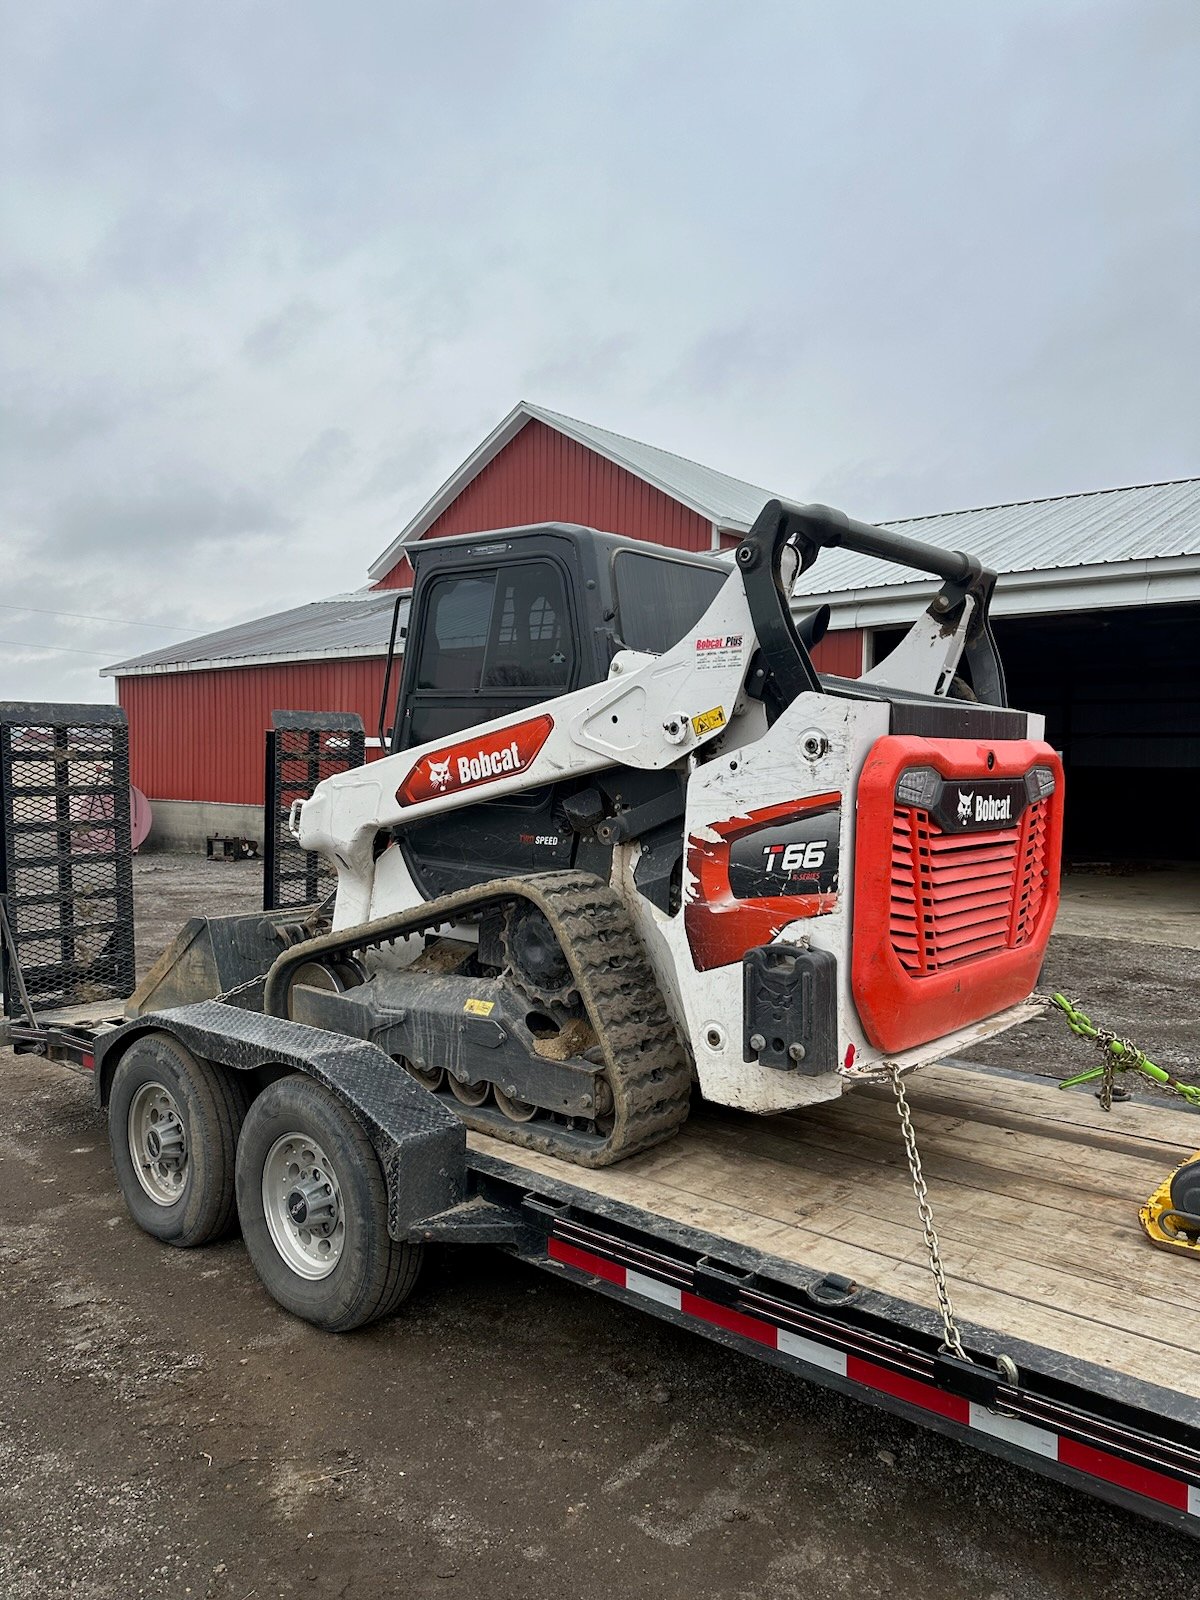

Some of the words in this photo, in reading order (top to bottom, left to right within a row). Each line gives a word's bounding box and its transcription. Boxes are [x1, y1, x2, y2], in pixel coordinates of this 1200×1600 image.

[696, 638, 723, 649] Bobcat
[725, 636, 743, 647] Plus
[457, 741, 521, 784] Bobcat
[975, 794, 1011, 822] Bobcat
[535, 836, 559, 846] SPEED
[763, 840, 829, 872] T66
